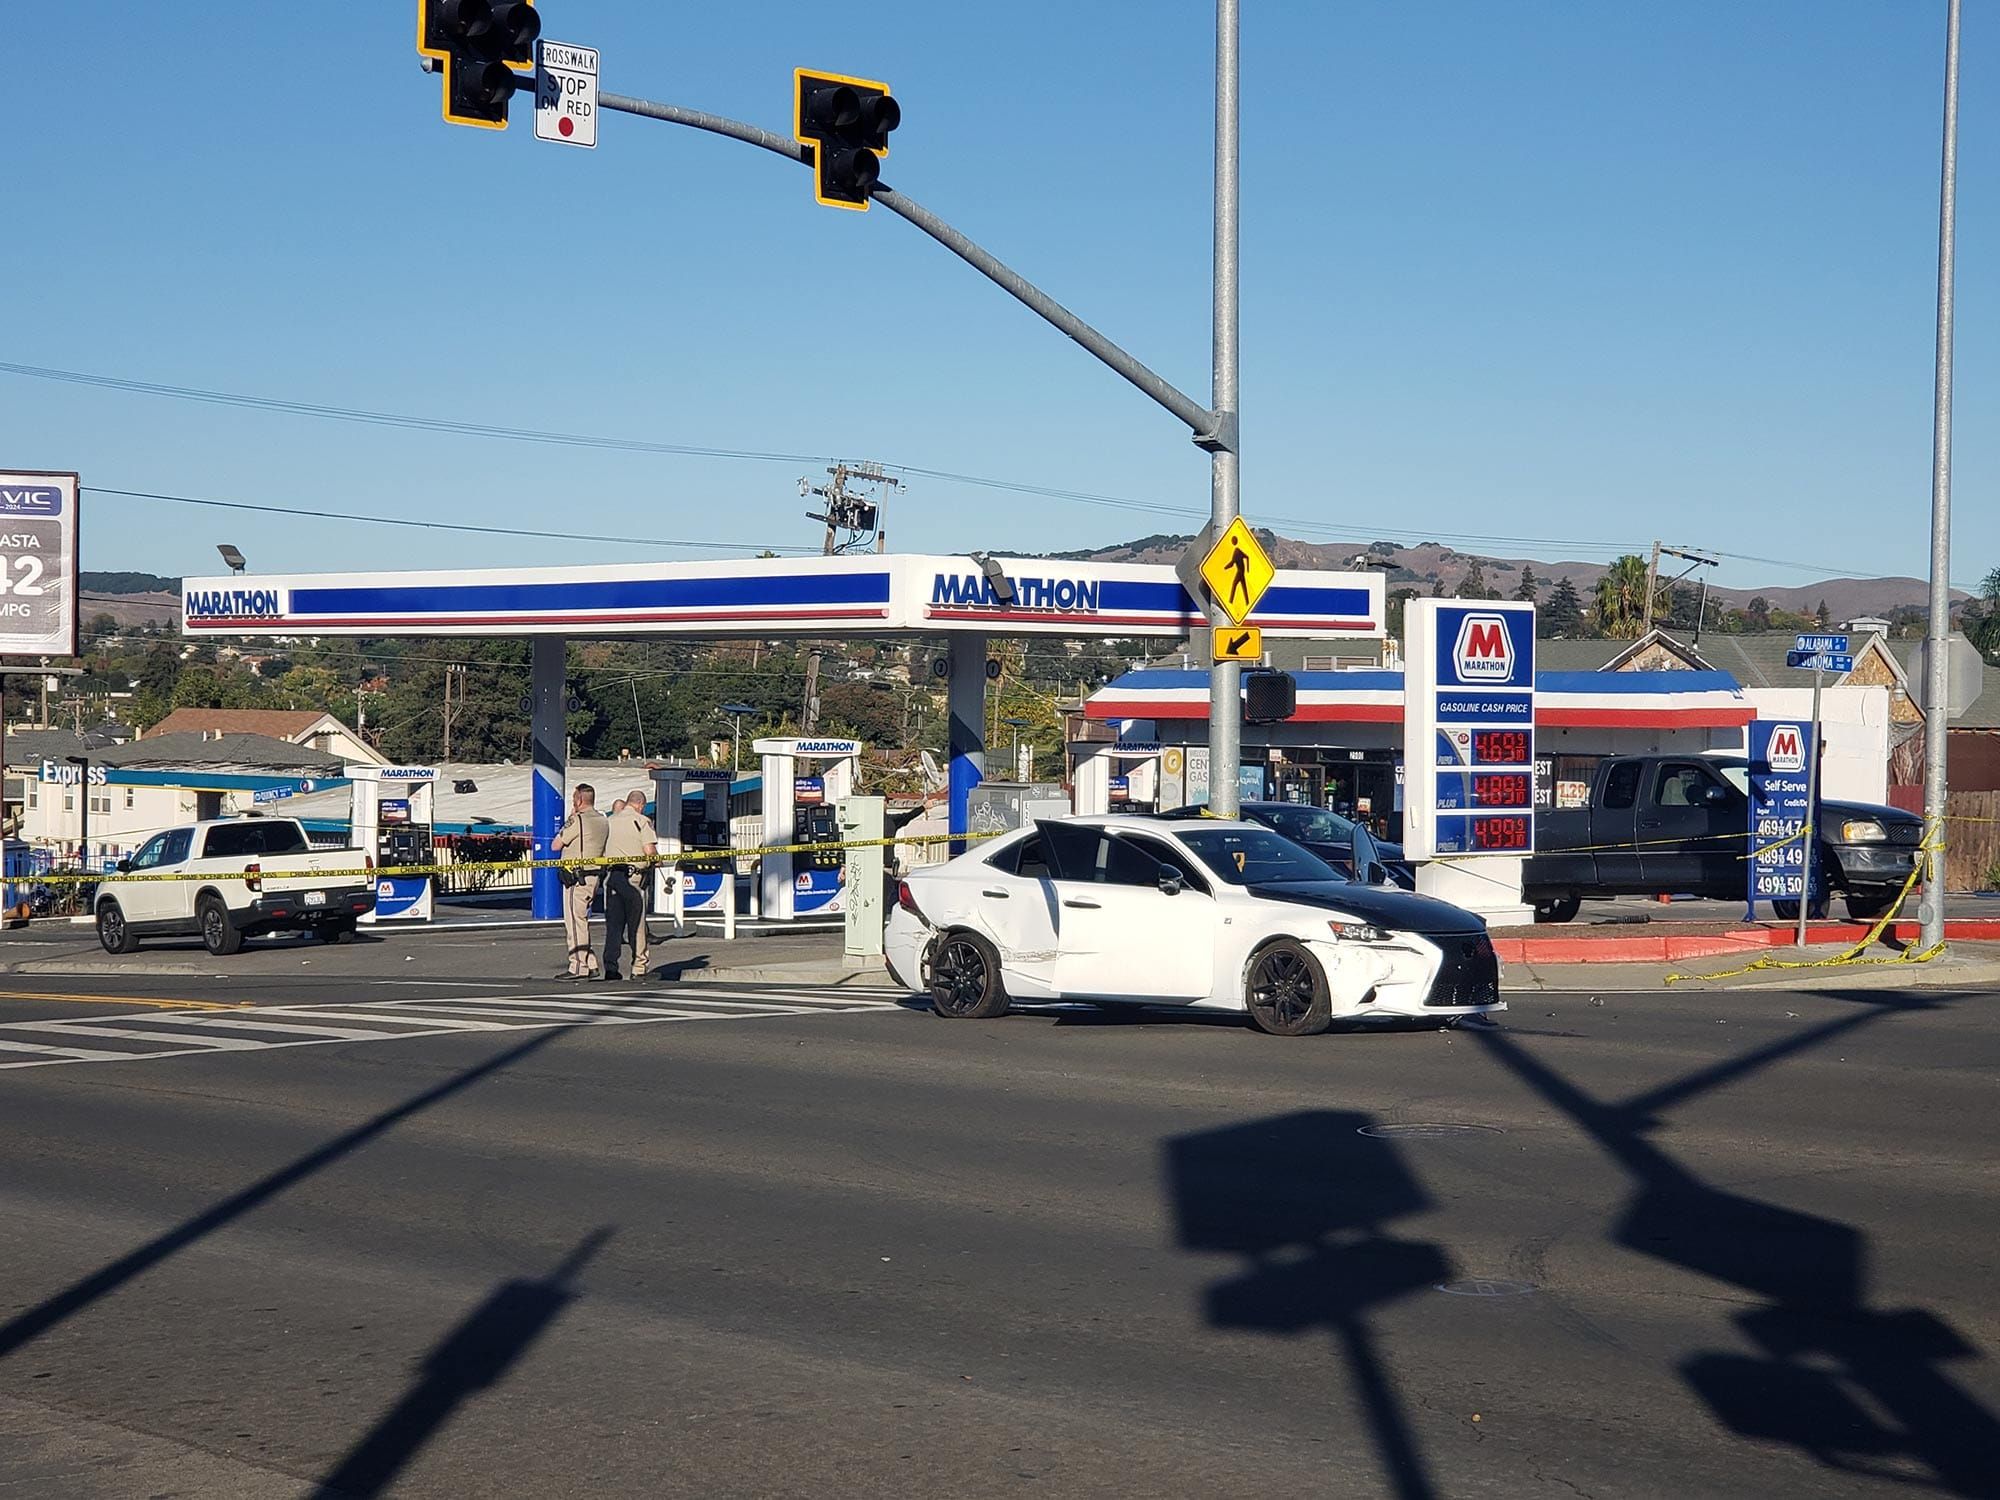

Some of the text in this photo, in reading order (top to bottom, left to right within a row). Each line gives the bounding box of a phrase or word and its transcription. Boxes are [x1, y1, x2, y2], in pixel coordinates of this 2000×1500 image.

[540, 46, 596, 70] CROSSWALK
[548, 75, 587, 96] STOP
[542, 96, 592, 116] ON RED
[0, 491, 51, 505] VIC
[186, 590, 278, 615] MARATHON
[0, 604, 31, 617] MPG
[1466, 624, 1505, 658] M
[1804, 637, 1832, 650] ALABAMA
[1464, 660, 1506, 671] MARATHON
[1801, 654, 1833, 668] SONOMA
[1440, 702, 1528, 713] GASOLINE CASH PRICE
[796, 742, 854, 751] MARATHON
[1112, 742, 1160, 751] MARATHON
[1774, 734, 1798, 754] M
[43, 760, 107, 788] Exprss
[380, 769, 434, 777] MARATHON
[686, 770, 732, 778] MARATHON
[1534, 760, 1552, 775] EST
[1189, 771, 1208, 782] GAS
[1558, 783, 1586, 798] 1.29
[1764, 780, 1807, 792] Self Serve
[1534, 789, 1552, 804] EST
[1438, 800, 1457, 808] PLUS
[1785, 820, 1803, 836] 4.7
[1786, 848, 1803, 864] 49
